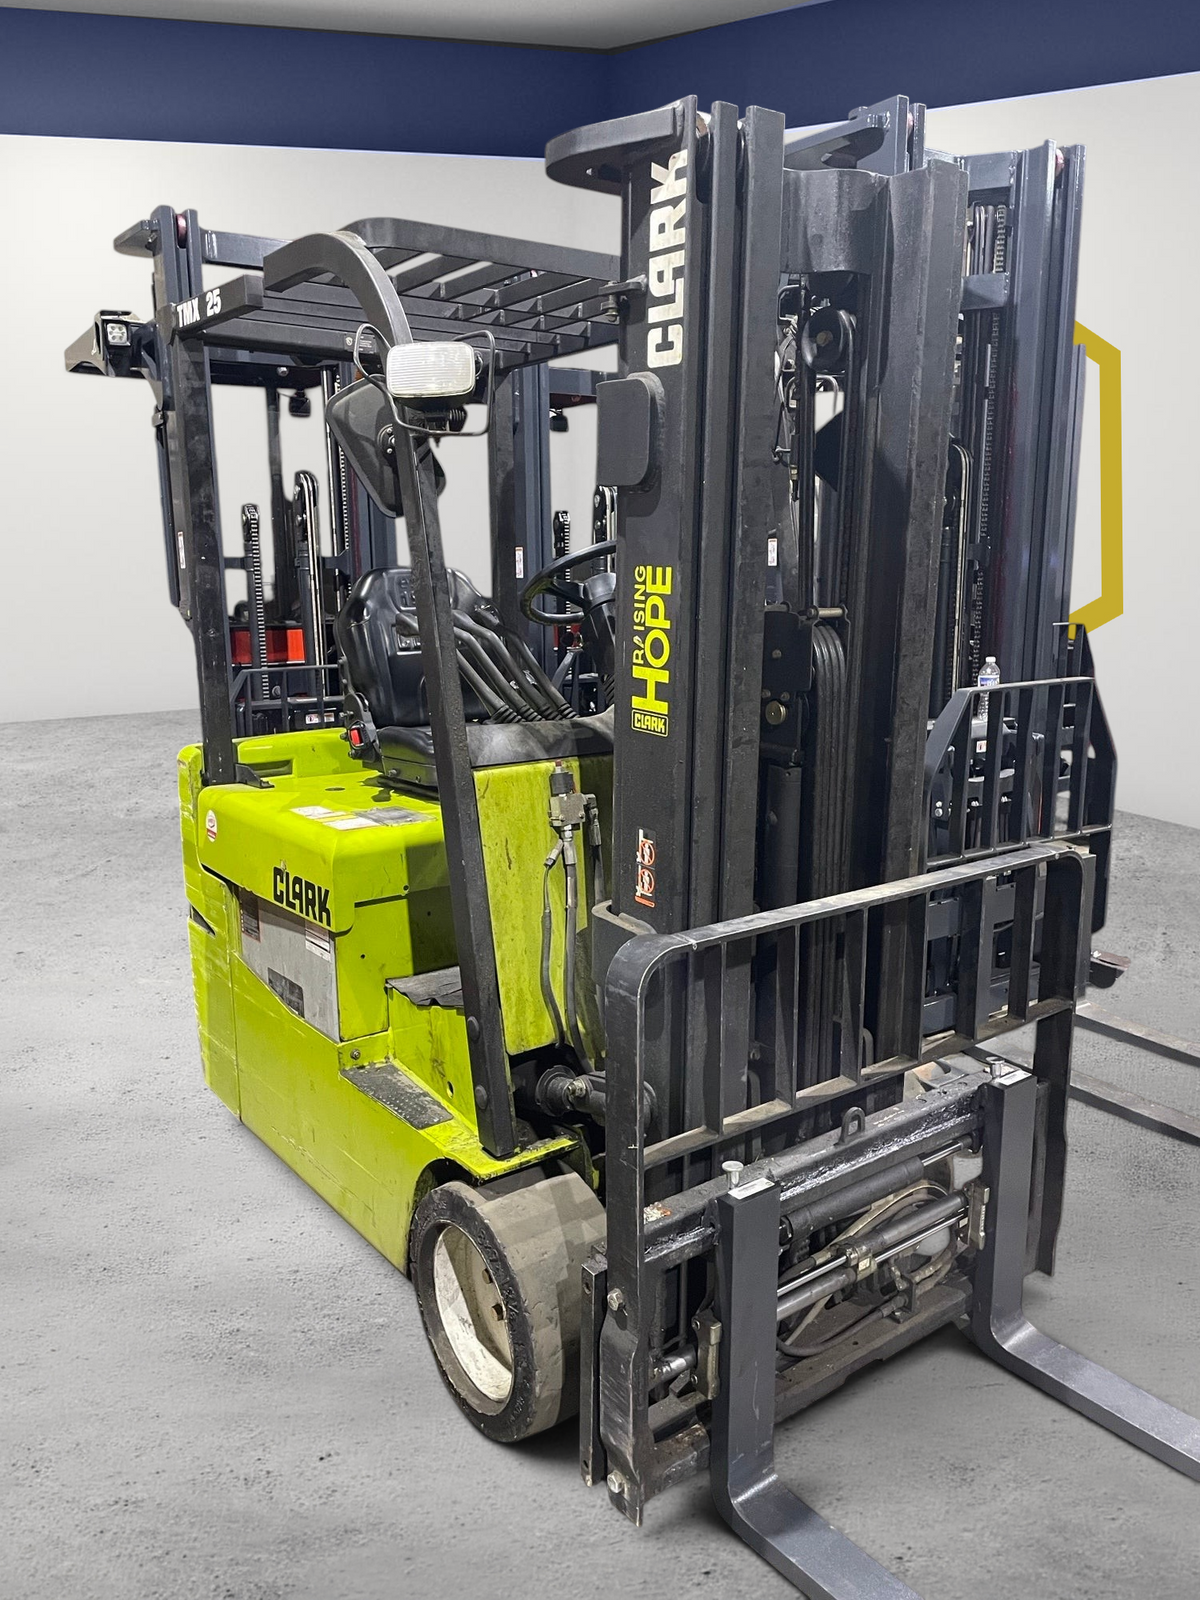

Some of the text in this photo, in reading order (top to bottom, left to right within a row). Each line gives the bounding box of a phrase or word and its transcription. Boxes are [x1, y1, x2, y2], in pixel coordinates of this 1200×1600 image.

[647, 149, 687, 368] CLARK
[176, 288, 221, 328] TMX 25
[631, 565, 672, 715] HOPE
[634, 712, 666, 734] CLARK
[273, 866, 331, 927] CLARK
